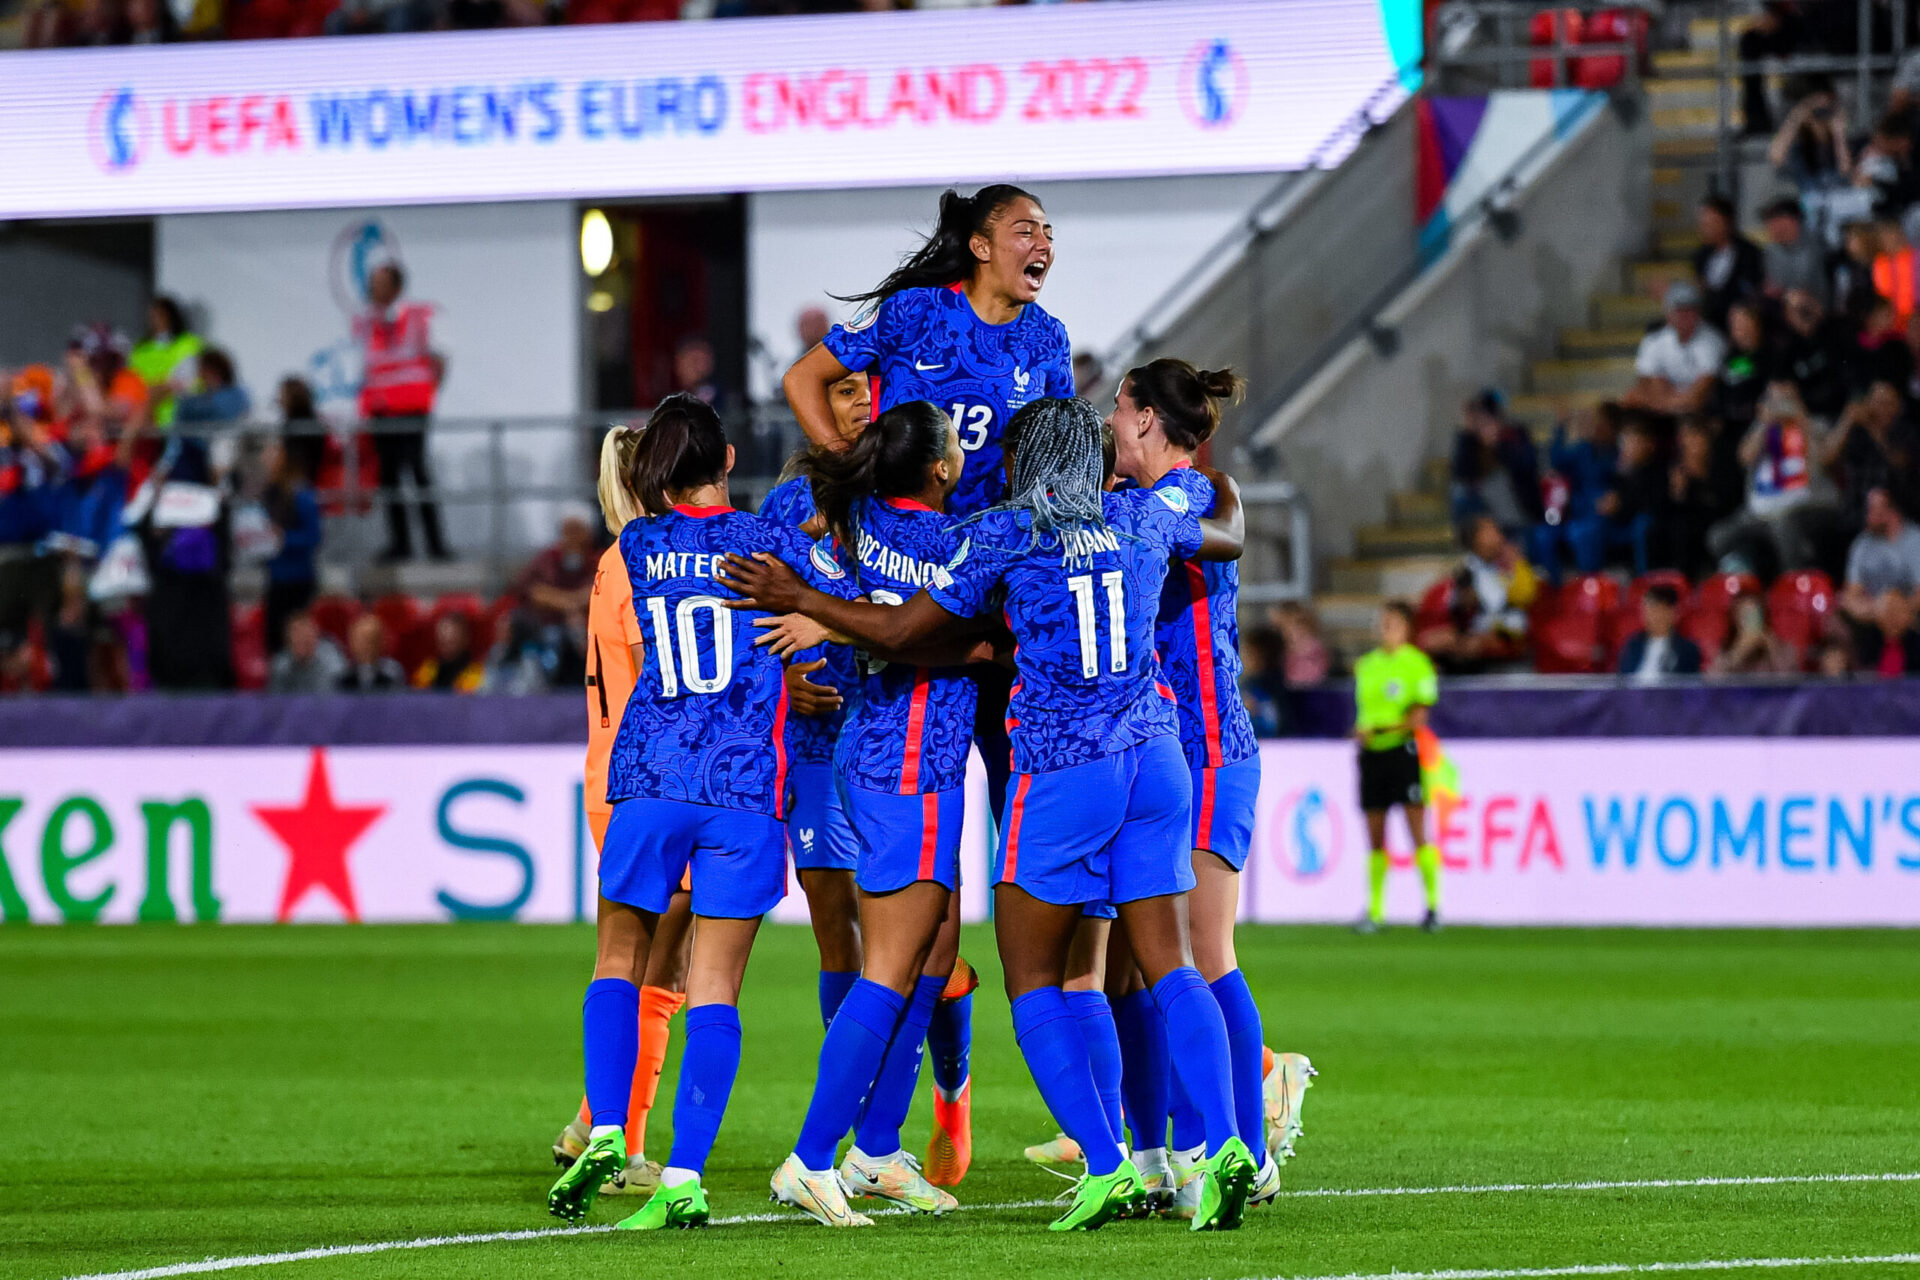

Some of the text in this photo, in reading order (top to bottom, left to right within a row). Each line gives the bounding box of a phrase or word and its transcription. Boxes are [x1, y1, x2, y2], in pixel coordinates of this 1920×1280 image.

[163, 57, 1148, 156] UEFA WOMEN'S EURO ENGLAND 2022
[952, 403, 992, 450] 13
[646, 552, 726, 582] MATEO
[647, 595, 732, 697] 10
[1067, 570, 1127, 679] 11
[1384, 794, 1920, 870] EFA WOMEN'S
